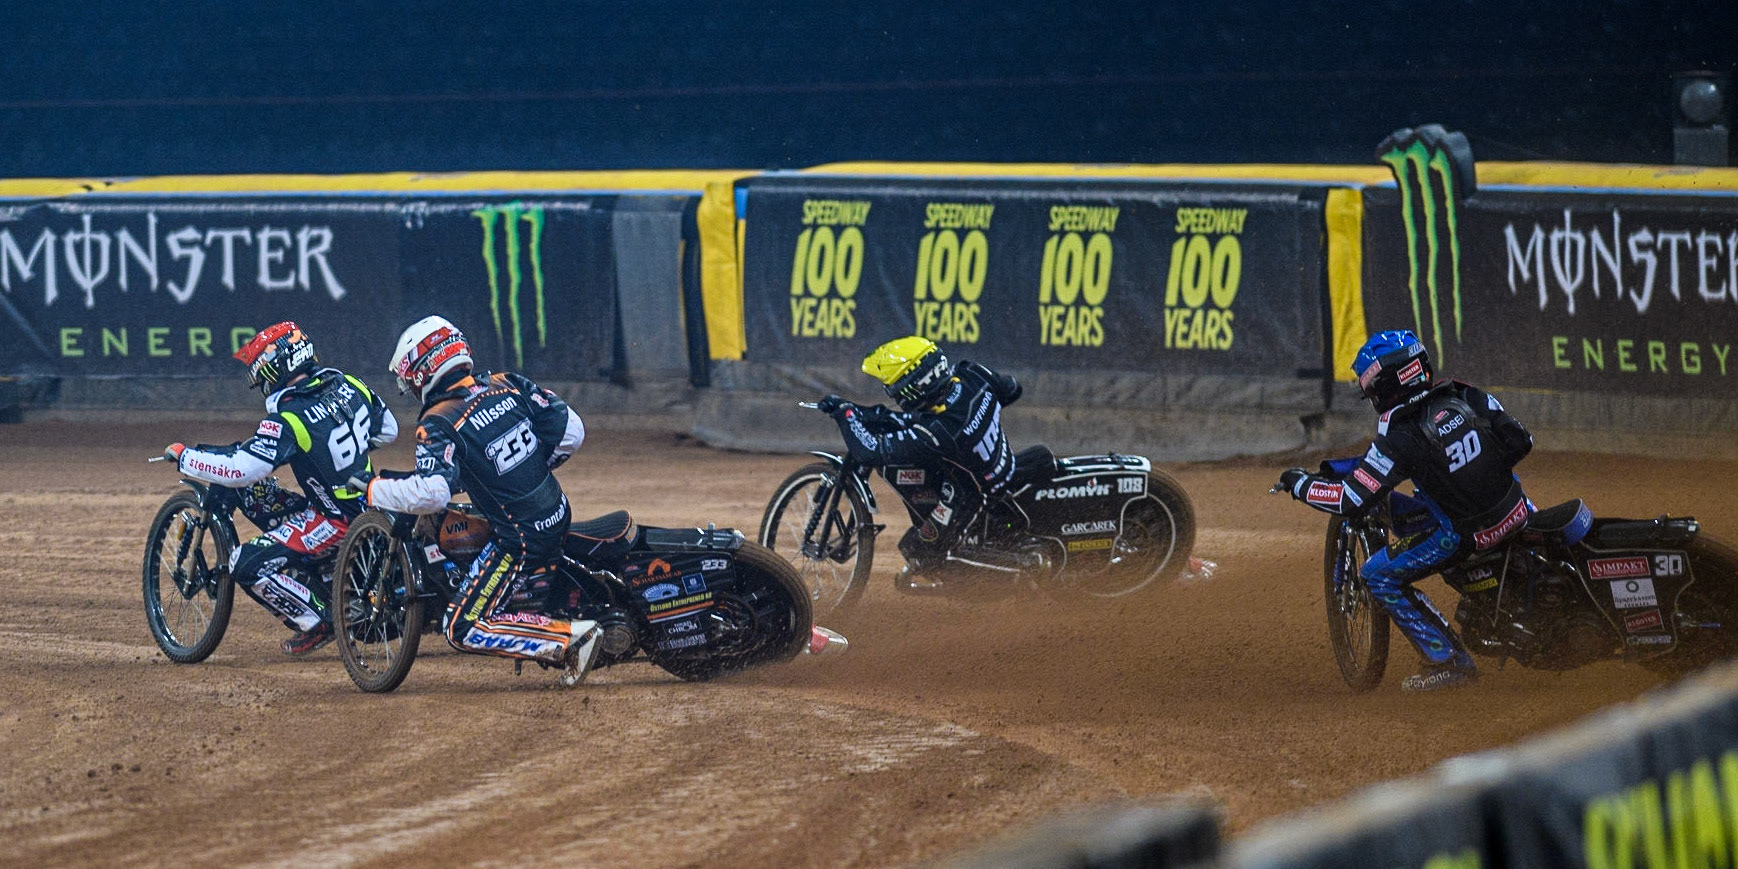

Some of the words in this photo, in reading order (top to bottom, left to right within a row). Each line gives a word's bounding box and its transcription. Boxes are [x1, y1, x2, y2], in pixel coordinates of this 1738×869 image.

[801, 200, 871, 225] SPEEDWAY
[924, 203, 995, 229] SPEEDWAY
[1048, 206, 1119, 232] SPEEDWAY
[1174, 208, 1247, 234] SPEEDWAY
[0, 212, 346, 308] MONSTER
[790, 226, 864, 298] 100
[914, 229, 989, 301] 100
[1038, 232, 1113, 306] 100
[1164, 235, 1242, 309] 100
[790, 298, 857, 339] YEARS
[914, 301, 981, 344] YEARS
[1039, 305, 1105, 347] YEARS
[1164, 308, 1235, 350] YEARS
[60, 327, 258, 358] ENERG
[1552, 336, 1731, 376] ENERGY
[260, 421, 281, 434] NGK
[327, 403, 371, 472] 66
[1445, 429, 1482, 473] 30
[1035, 477, 1111, 500] PLOMYK
[1117, 477, 1144, 494] 108
[1309, 487, 1339, 500] KLOSTER
[1655, 553, 1683, 576] 30
